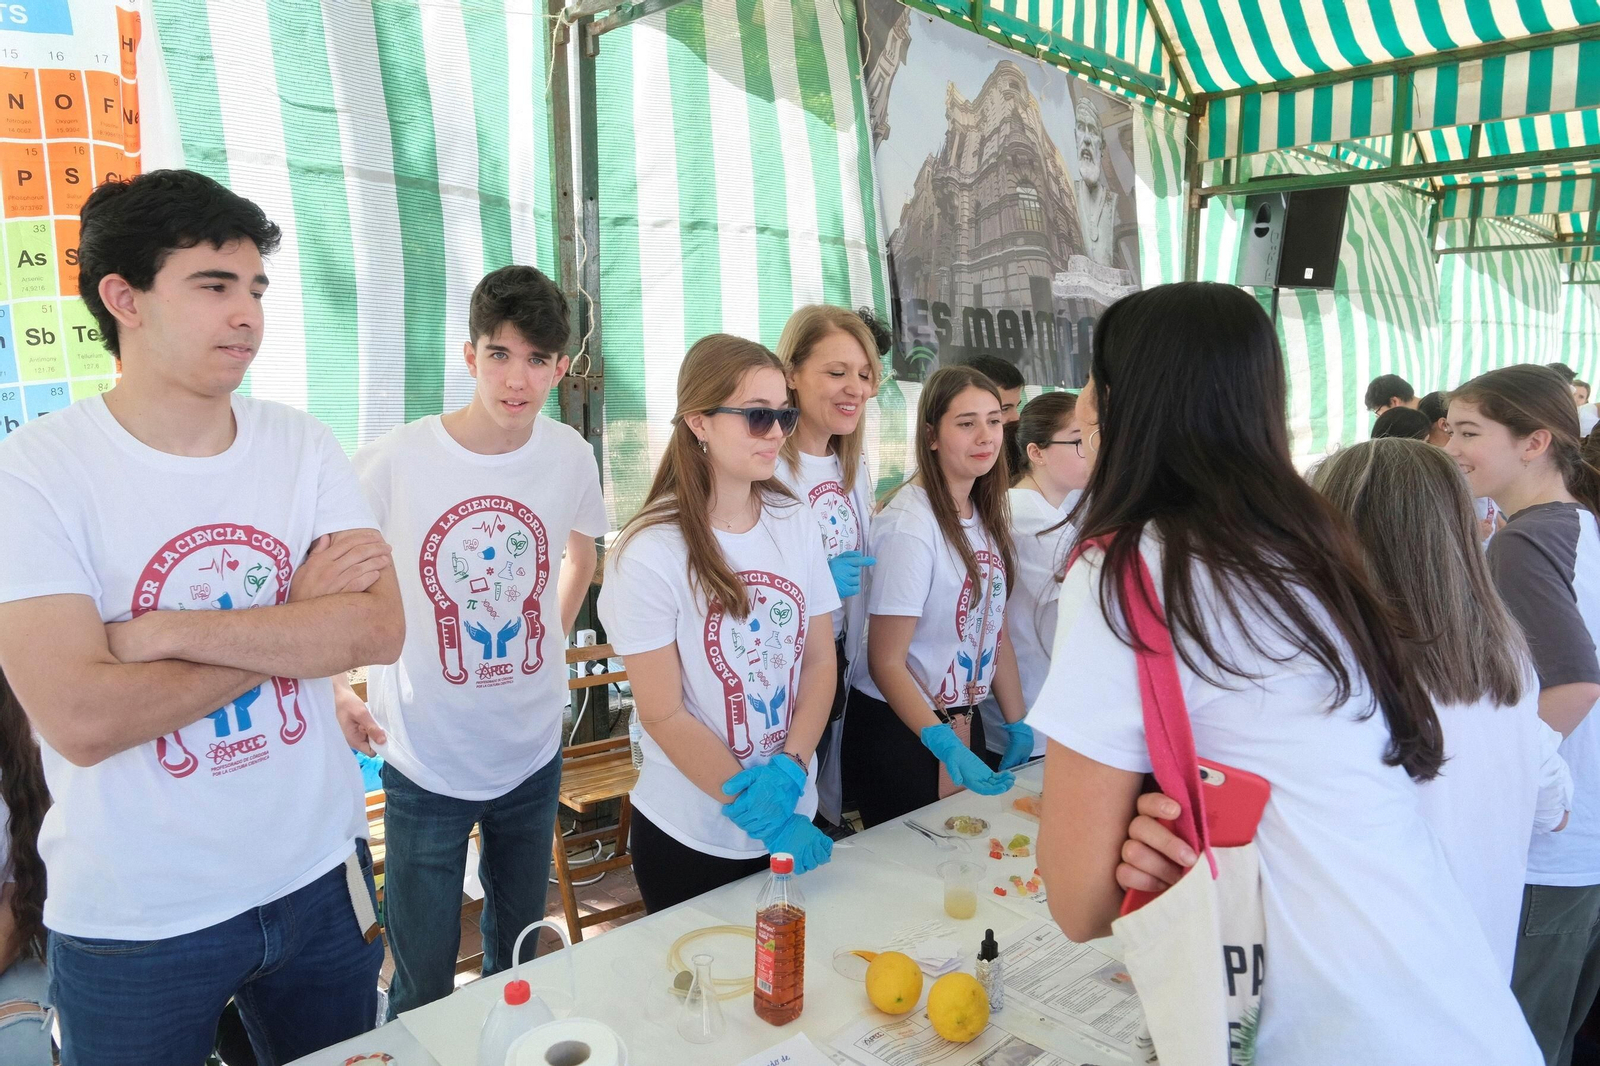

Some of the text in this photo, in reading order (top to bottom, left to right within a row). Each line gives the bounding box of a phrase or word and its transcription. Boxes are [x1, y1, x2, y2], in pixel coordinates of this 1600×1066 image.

[3, 48, 109, 64] 15 16 17
[23, 72, 28, 80] 7
[69, 72, 76, 81] 8
[114, 78, 119, 86] 9
[8, 93, 24, 110] N
[54, 94, 73, 110] O
[104, 98, 114, 114] F
[123, 108, 140, 125] Ne
[25, 148, 38, 156] 15
[73, 146, 85, 155] 16
[115, 152, 124, 161] 17
[18, 170, 33, 187] P
[65, 168, 80, 185] S
[33, 224, 46, 233] 33
[17, 250, 47, 268] As
[42, 305, 53, 314] 51
[25, 327, 55, 346] Sb
[72, 326, 99, 343] Te
[34, 366, 55, 374] 121.76
[50, 387, 64, 396] 83
[98, 383, 109, 391] 84
[2, 392, 15, 401] 82
[458, 499, 514, 516] CIENCIA
[440, 512, 459, 531] LA
[518, 508, 547, 564] CÓRDOBA
[424, 532, 442, 562] POR
[138, 580, 160, 610] OR
[153, 550, 180, 574] LA
[175, 527, 247, 553] CIENCIA
[738, 573, 771, 584] NCIA
[424, 566, 451, 610] PASEO
[708, 612, 721, 641] POR
[710, 646, 739, 688] PASEO
